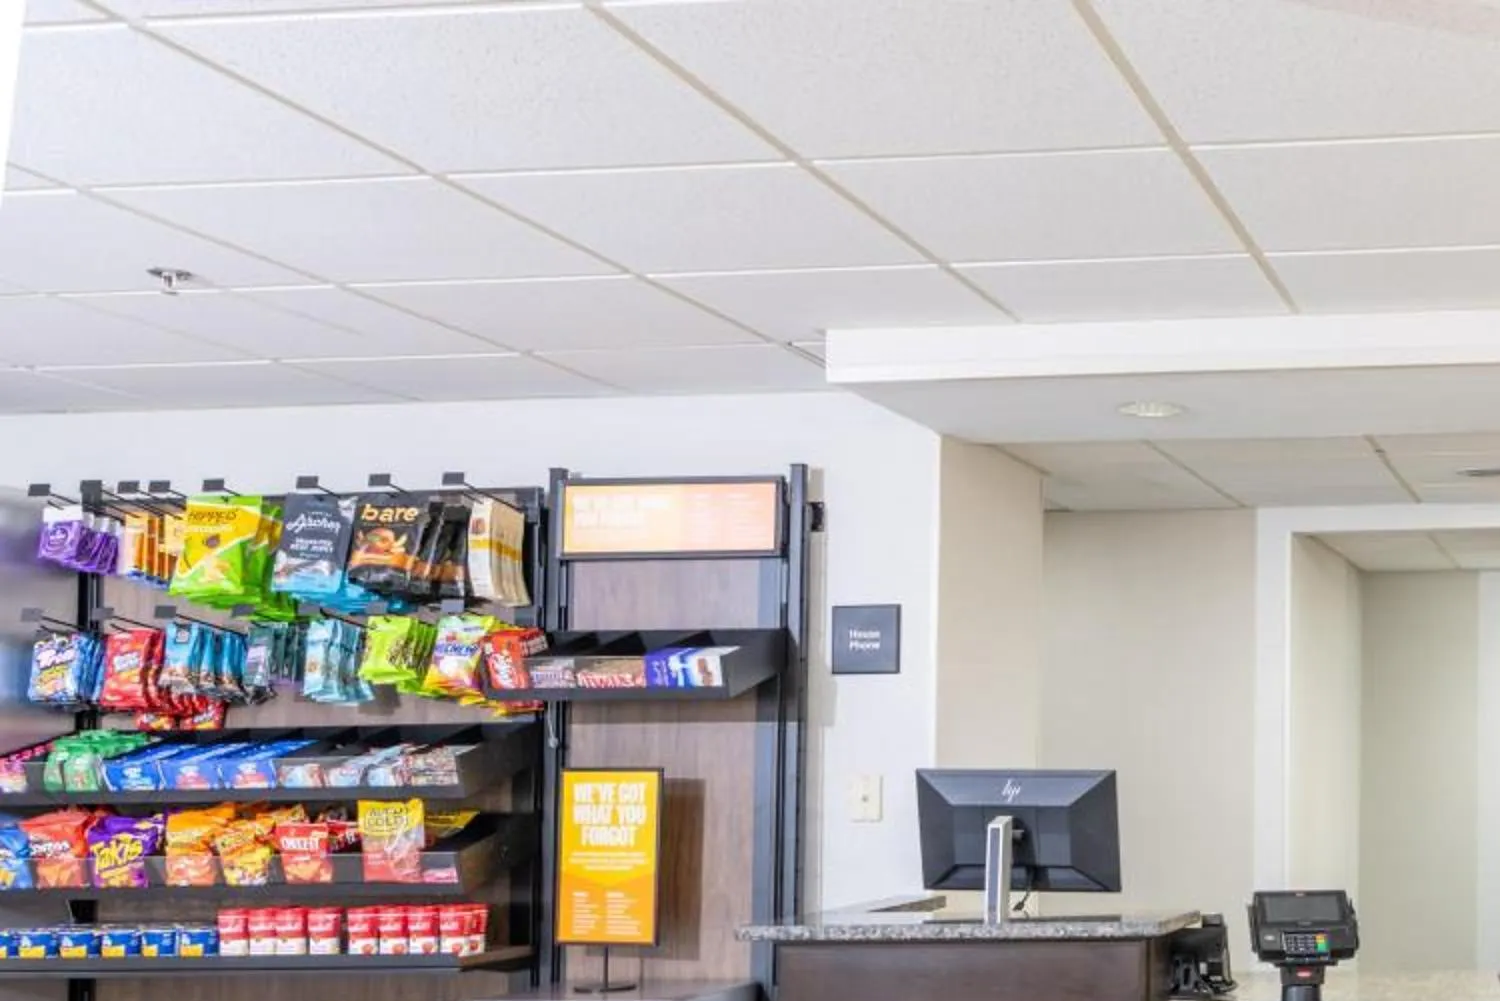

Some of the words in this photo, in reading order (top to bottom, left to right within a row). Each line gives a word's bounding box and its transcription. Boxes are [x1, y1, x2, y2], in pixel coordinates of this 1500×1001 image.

[361, 504, 418, 522] bare
[848, 629, 880, 639] House
[848, 641, 880, 651] Phone
[618, 783, 646, 802] GOT
[1002, 779, 1021, 802] hp
[573, 804, 612, 824] WHAT
[617, 804, 647, 824] YOU
[90, 833, 144, 872] Takis
